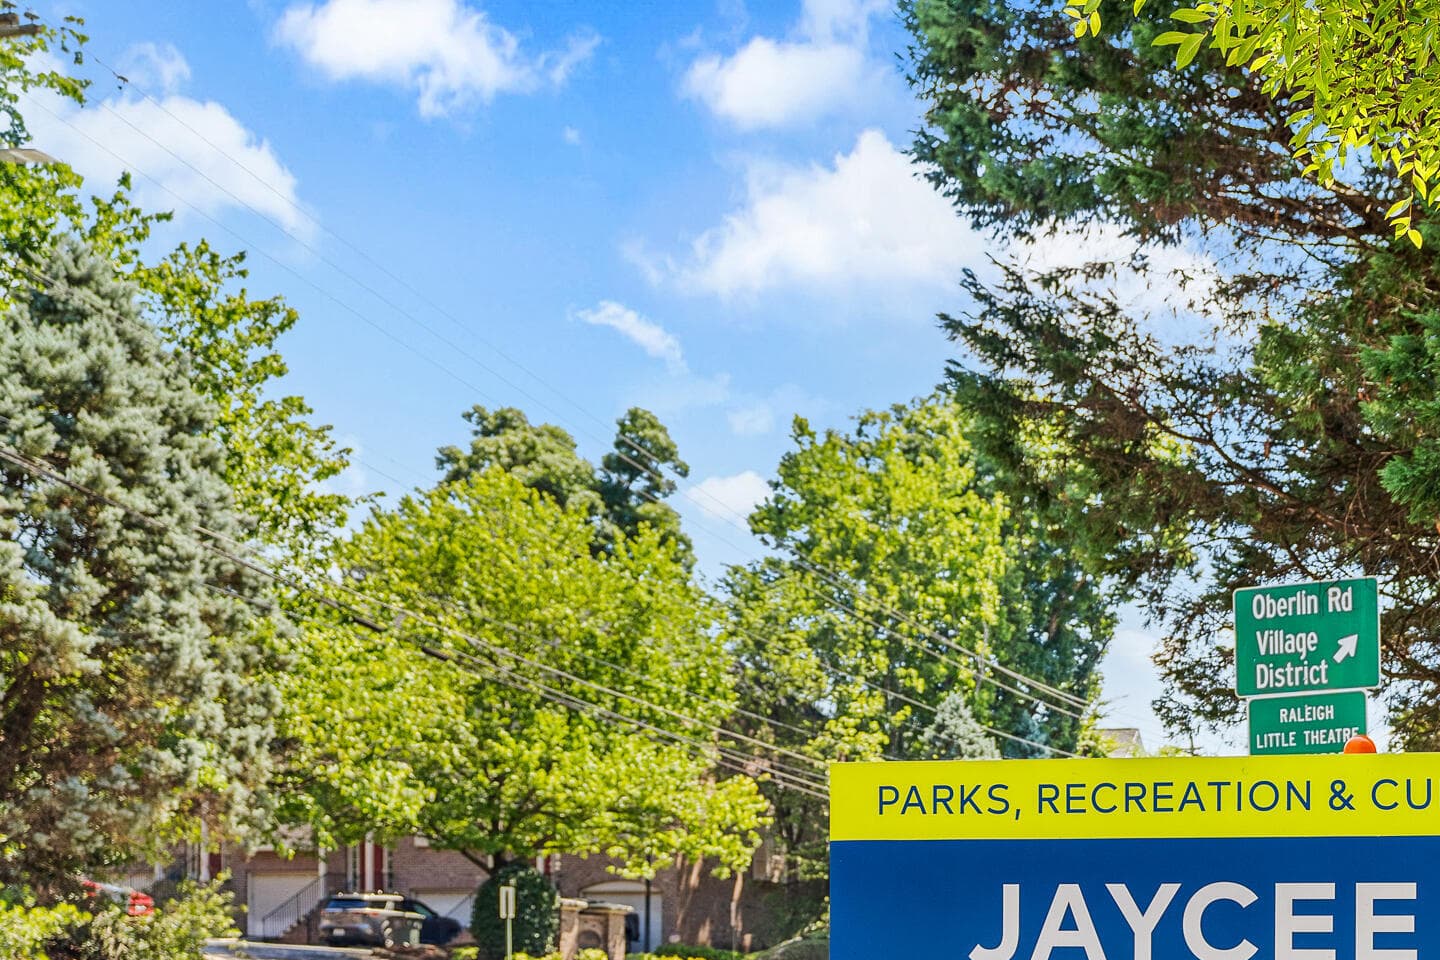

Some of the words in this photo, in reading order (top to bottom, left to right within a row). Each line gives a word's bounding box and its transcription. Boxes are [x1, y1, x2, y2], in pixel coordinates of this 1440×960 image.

[1252, 590, 1319, 620] Oberlin
[1327, 587, 1353, 613] Rd
[1256, 630, 1318, 660] Village
[1256, 659, 1329, 689] District
[1279, 705, 1335, 723] RALEIGH
[1256, 731, 1297, 749] LITTLE
[876, 783, 1021, 821] PARKS,
[1036, 780, 1312, 815] RECREATION
[1327, 778, 1356, 812] &
